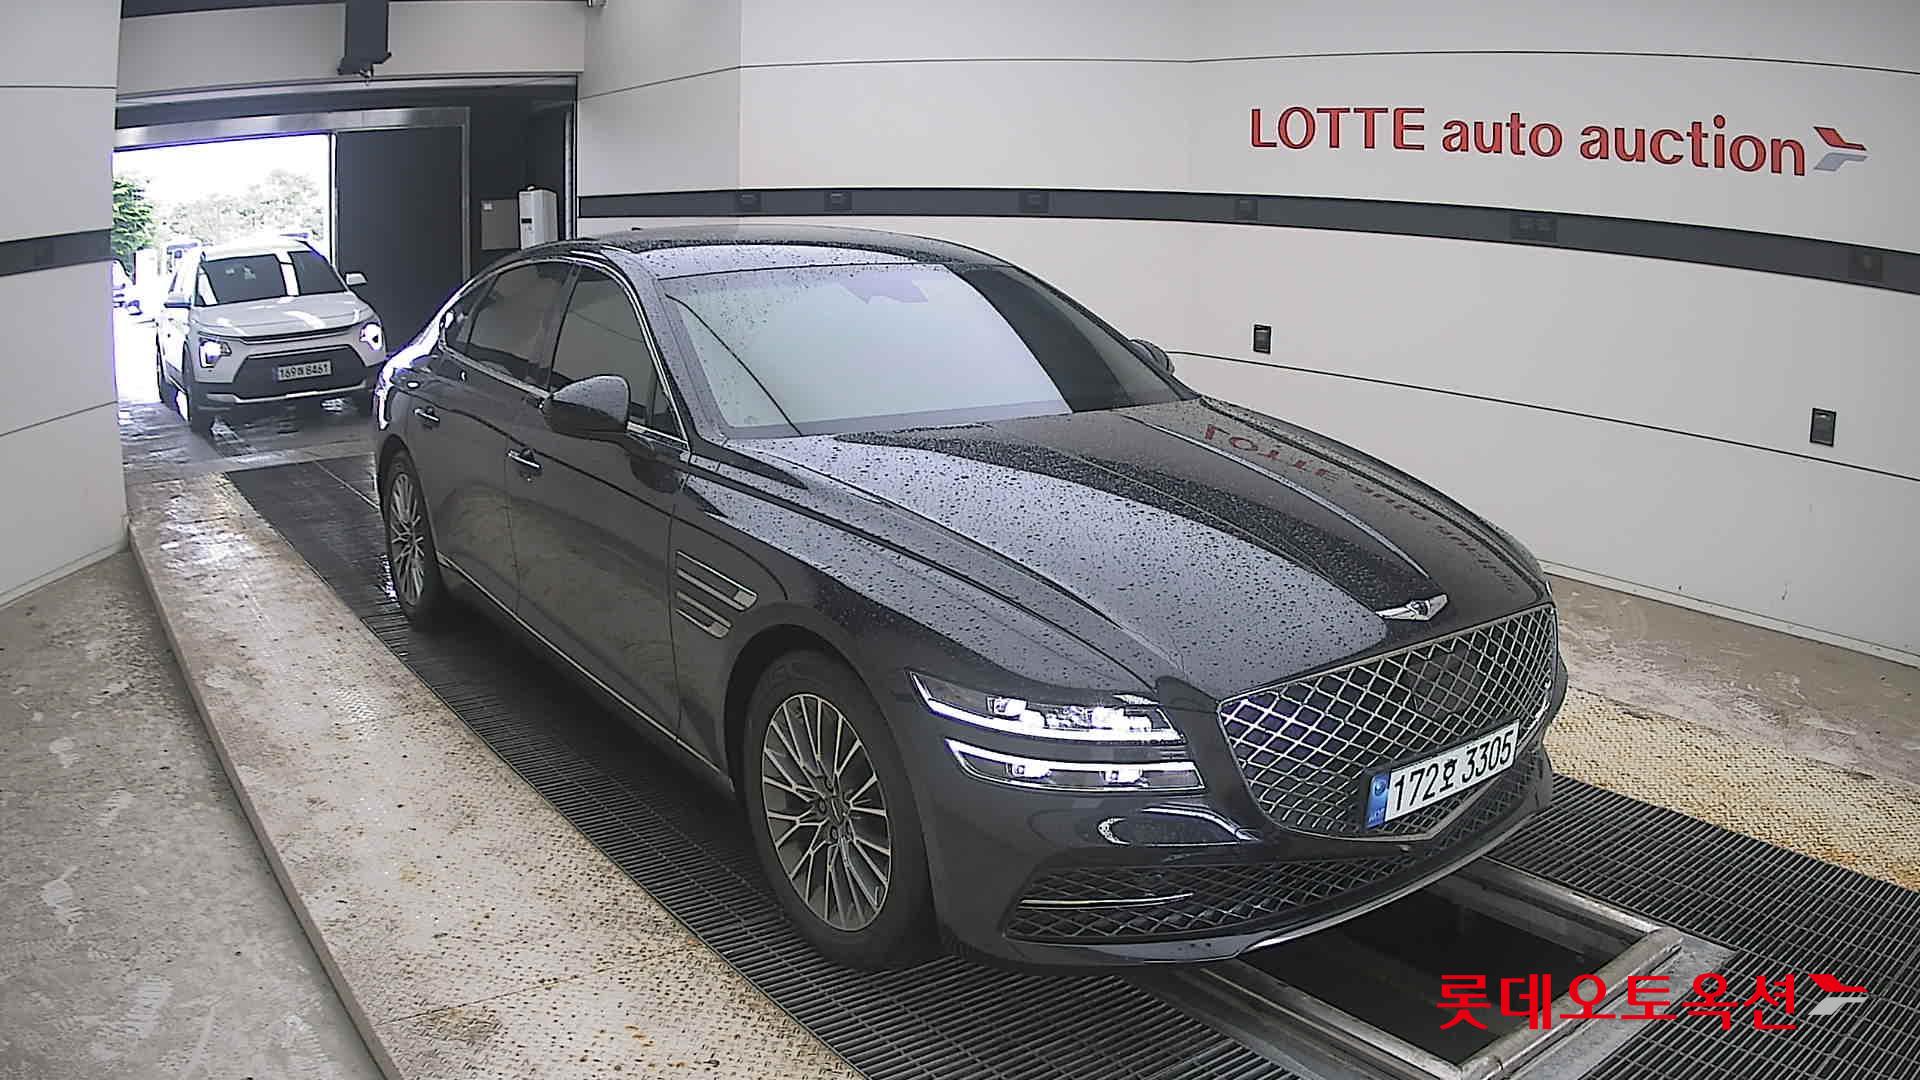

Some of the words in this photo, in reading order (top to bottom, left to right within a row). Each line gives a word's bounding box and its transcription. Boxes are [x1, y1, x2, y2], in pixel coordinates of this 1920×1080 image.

[1251, 107, 1425, 150] LOTTE
[1442, 112, 1564, 157] auto
[1579, 115, 1806, 175] auction
[1394, 758, 1458, 811] 172호
[1461, 730, 1515, 784] 3305
